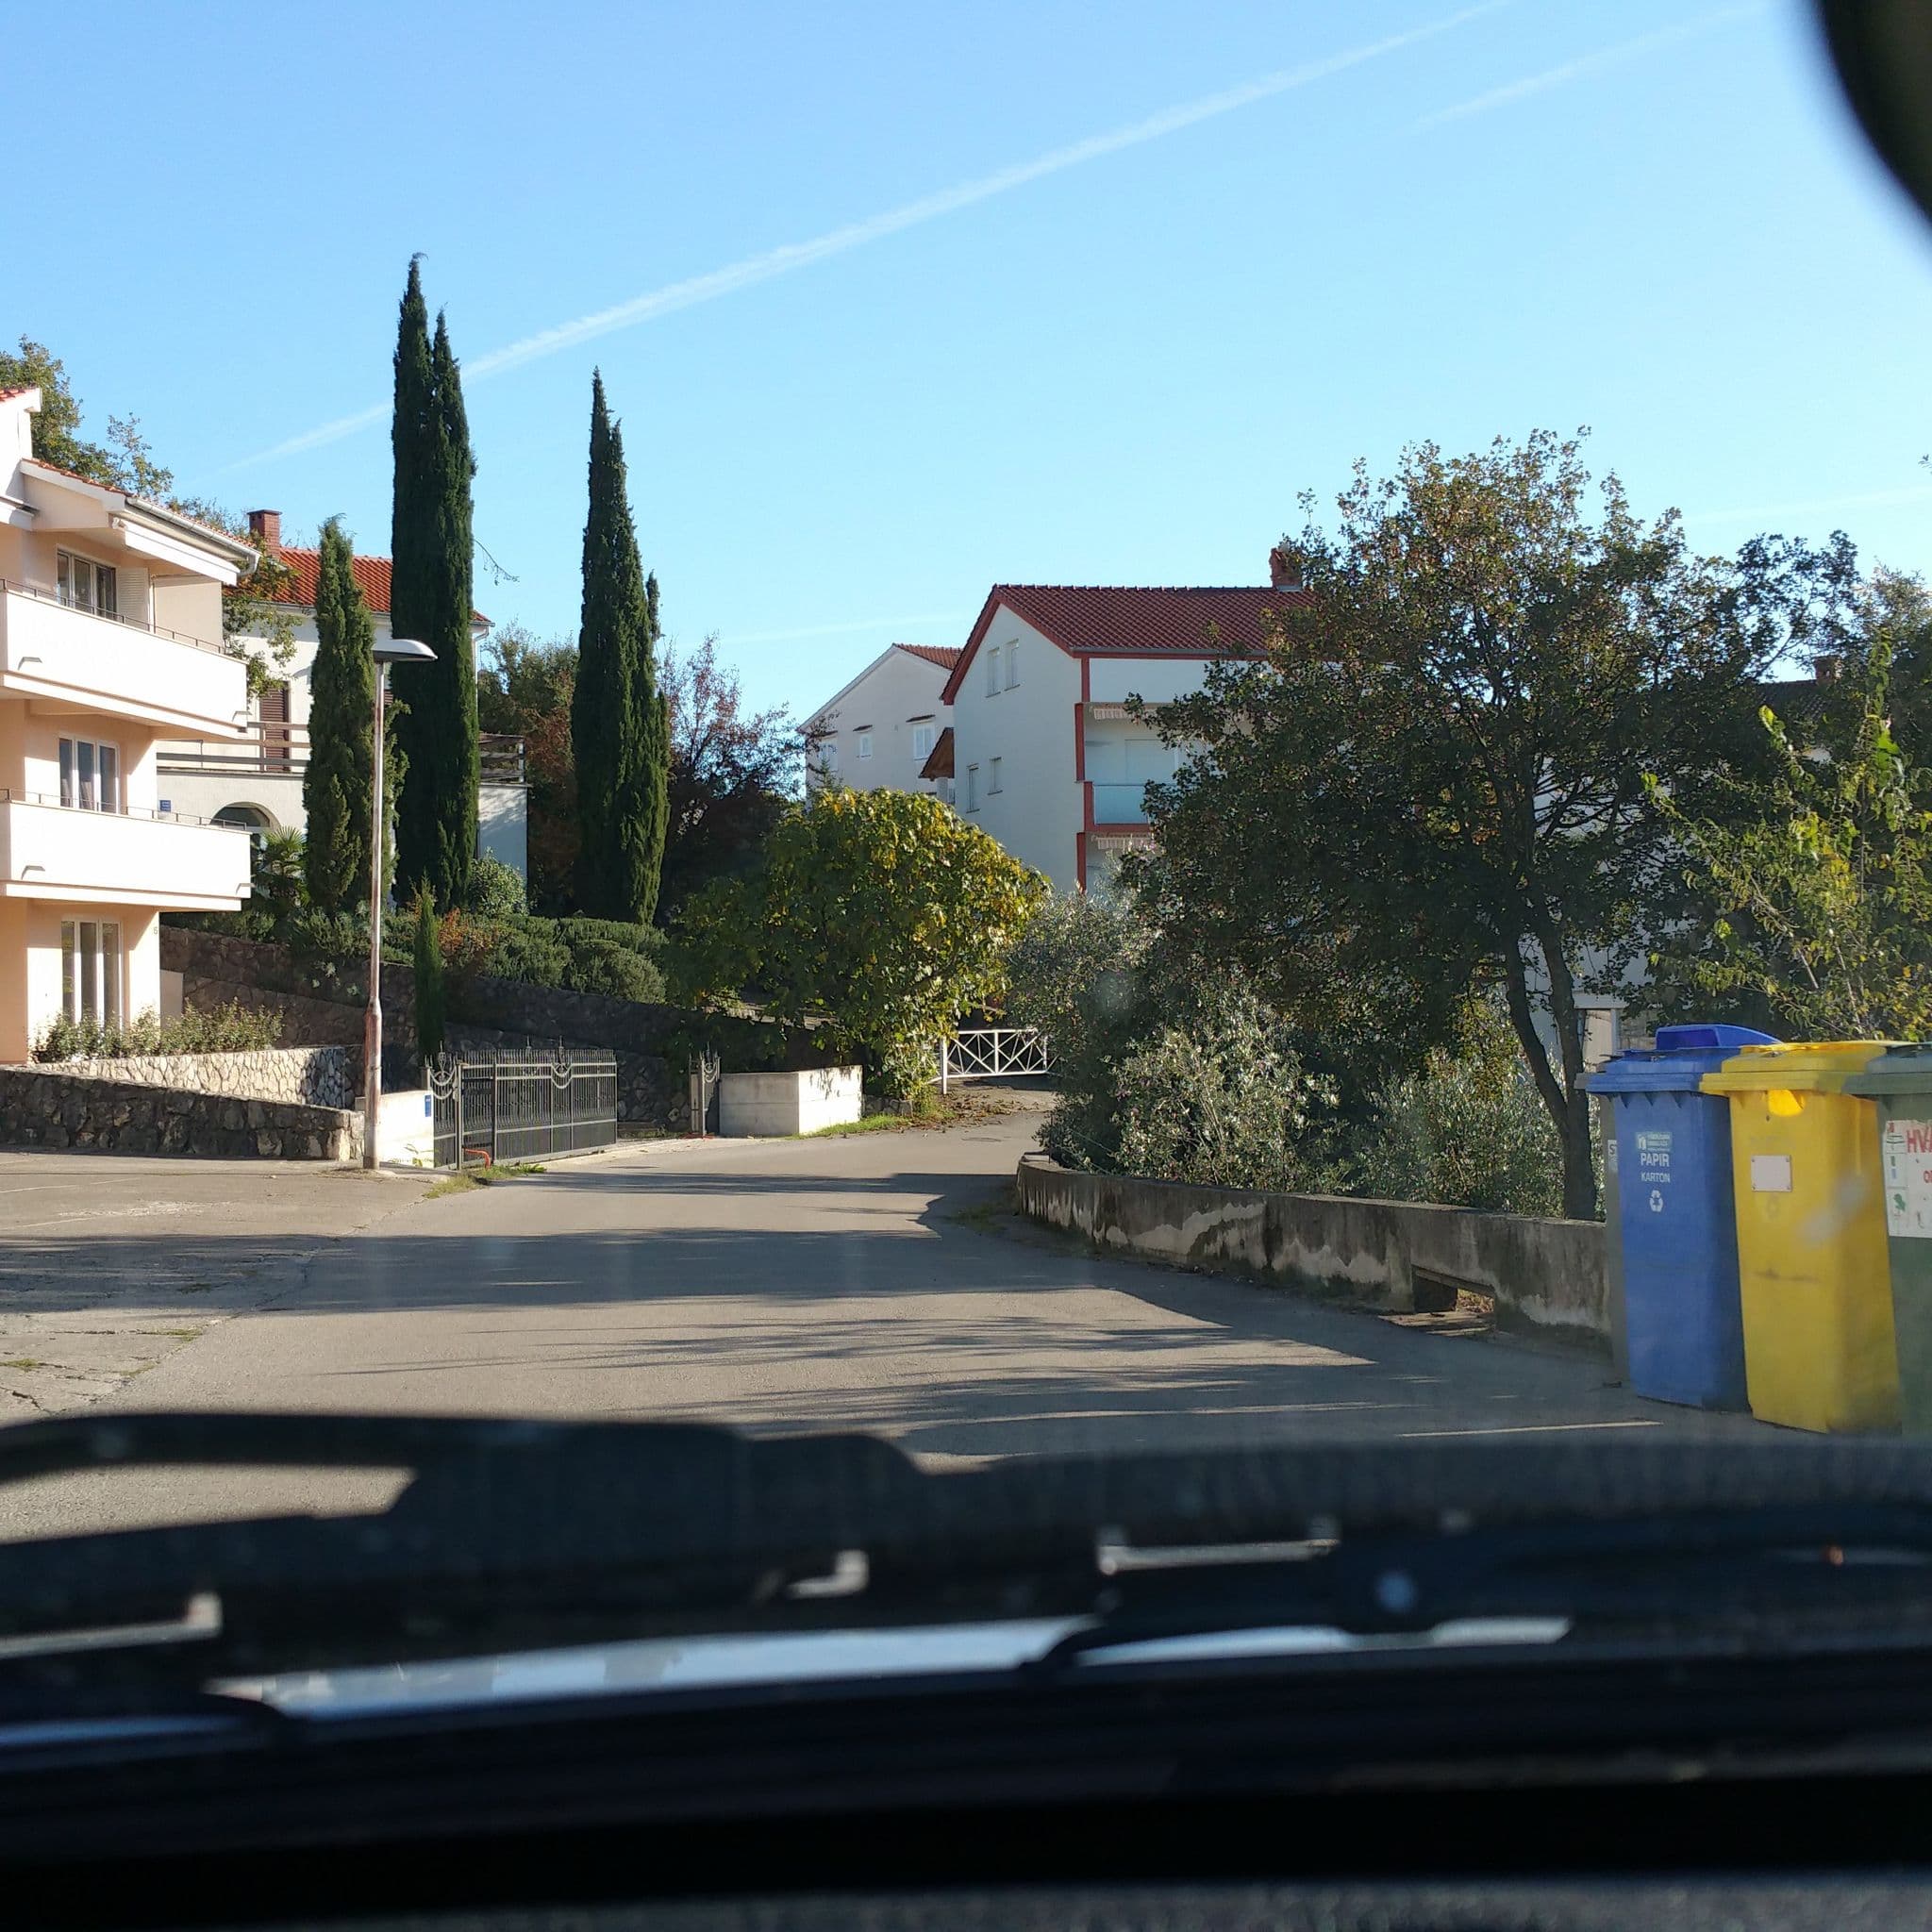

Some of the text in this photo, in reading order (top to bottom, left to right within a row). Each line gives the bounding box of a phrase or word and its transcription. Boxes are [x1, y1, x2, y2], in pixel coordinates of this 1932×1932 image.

[1907, 1128, 1932, 1153] HV
[1640, 1152, 1670, 1168] PAPIR
[1641, 1172, 1671, 1183] KARTON
